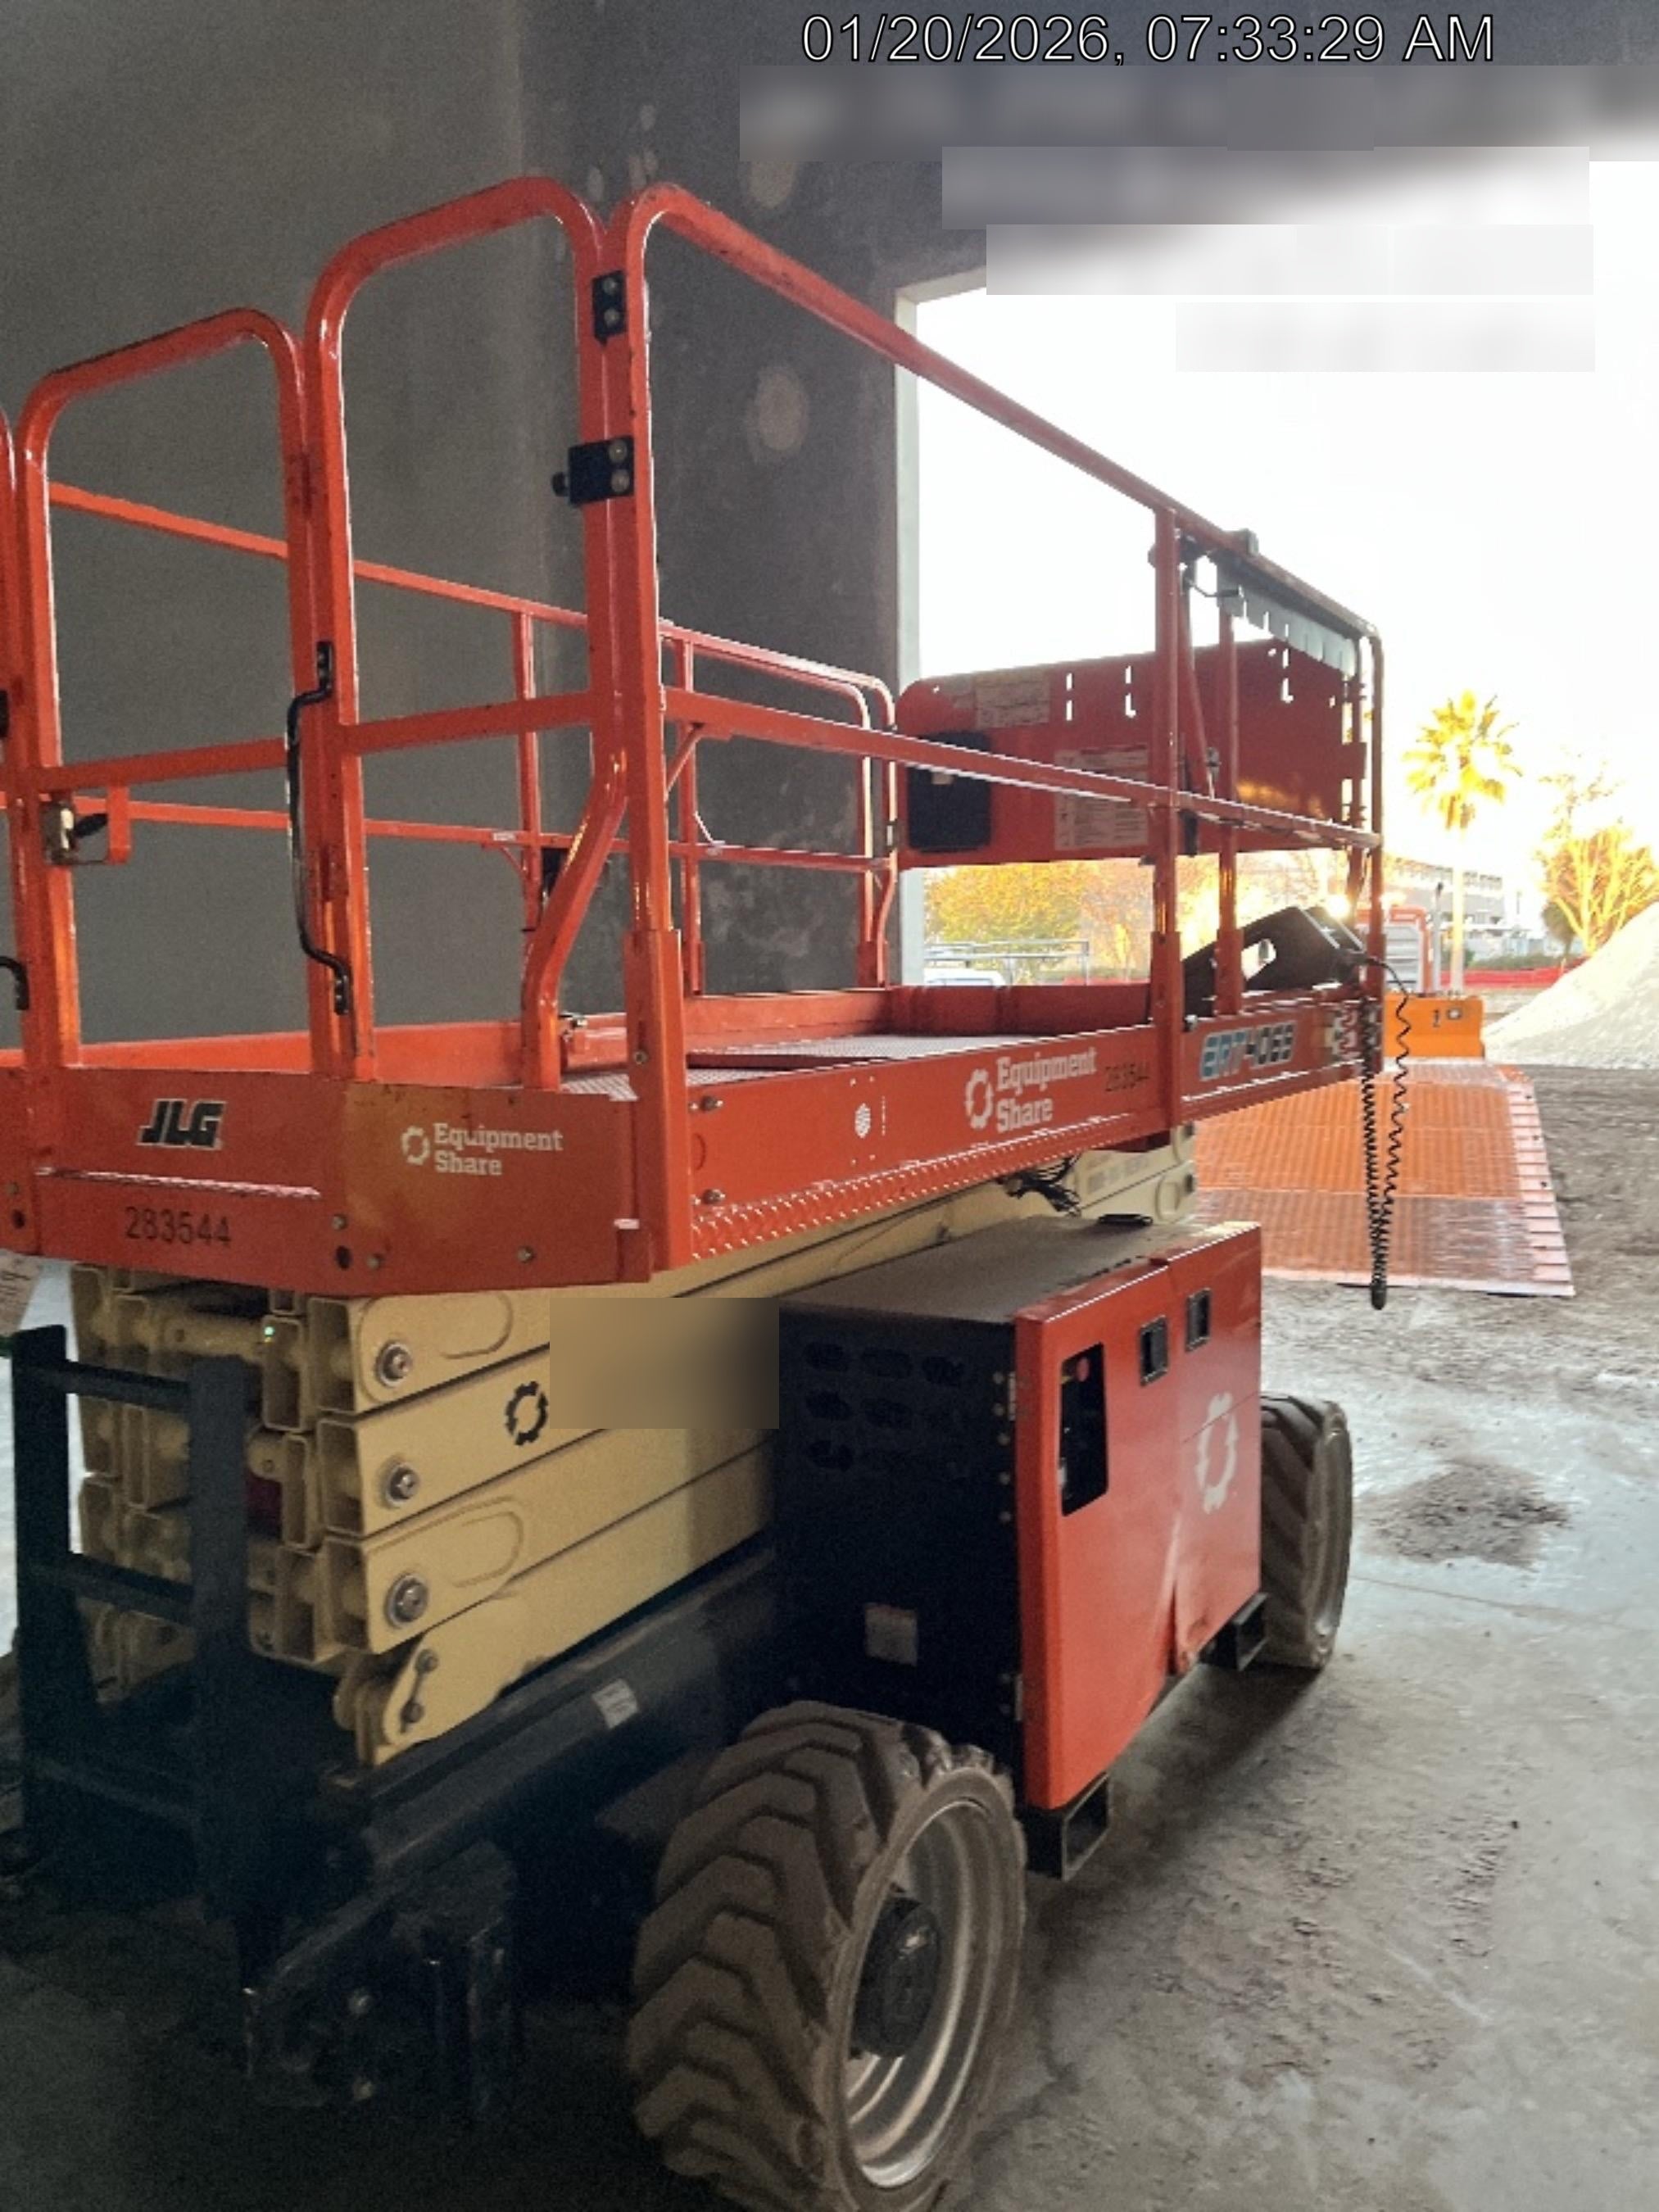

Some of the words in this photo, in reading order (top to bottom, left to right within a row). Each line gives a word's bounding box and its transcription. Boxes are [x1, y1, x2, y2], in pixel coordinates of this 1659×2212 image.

[996, 1046, 1097, 1096] Equipment
[136, 1098, 228, 1151] JLG
[996, 1097, 1054, 1134] Share
[433, 1122, 564, 1153] Equipment
[434, 1149, 503, 1176] Share
[125, 1206, 232, 1247] 283544
